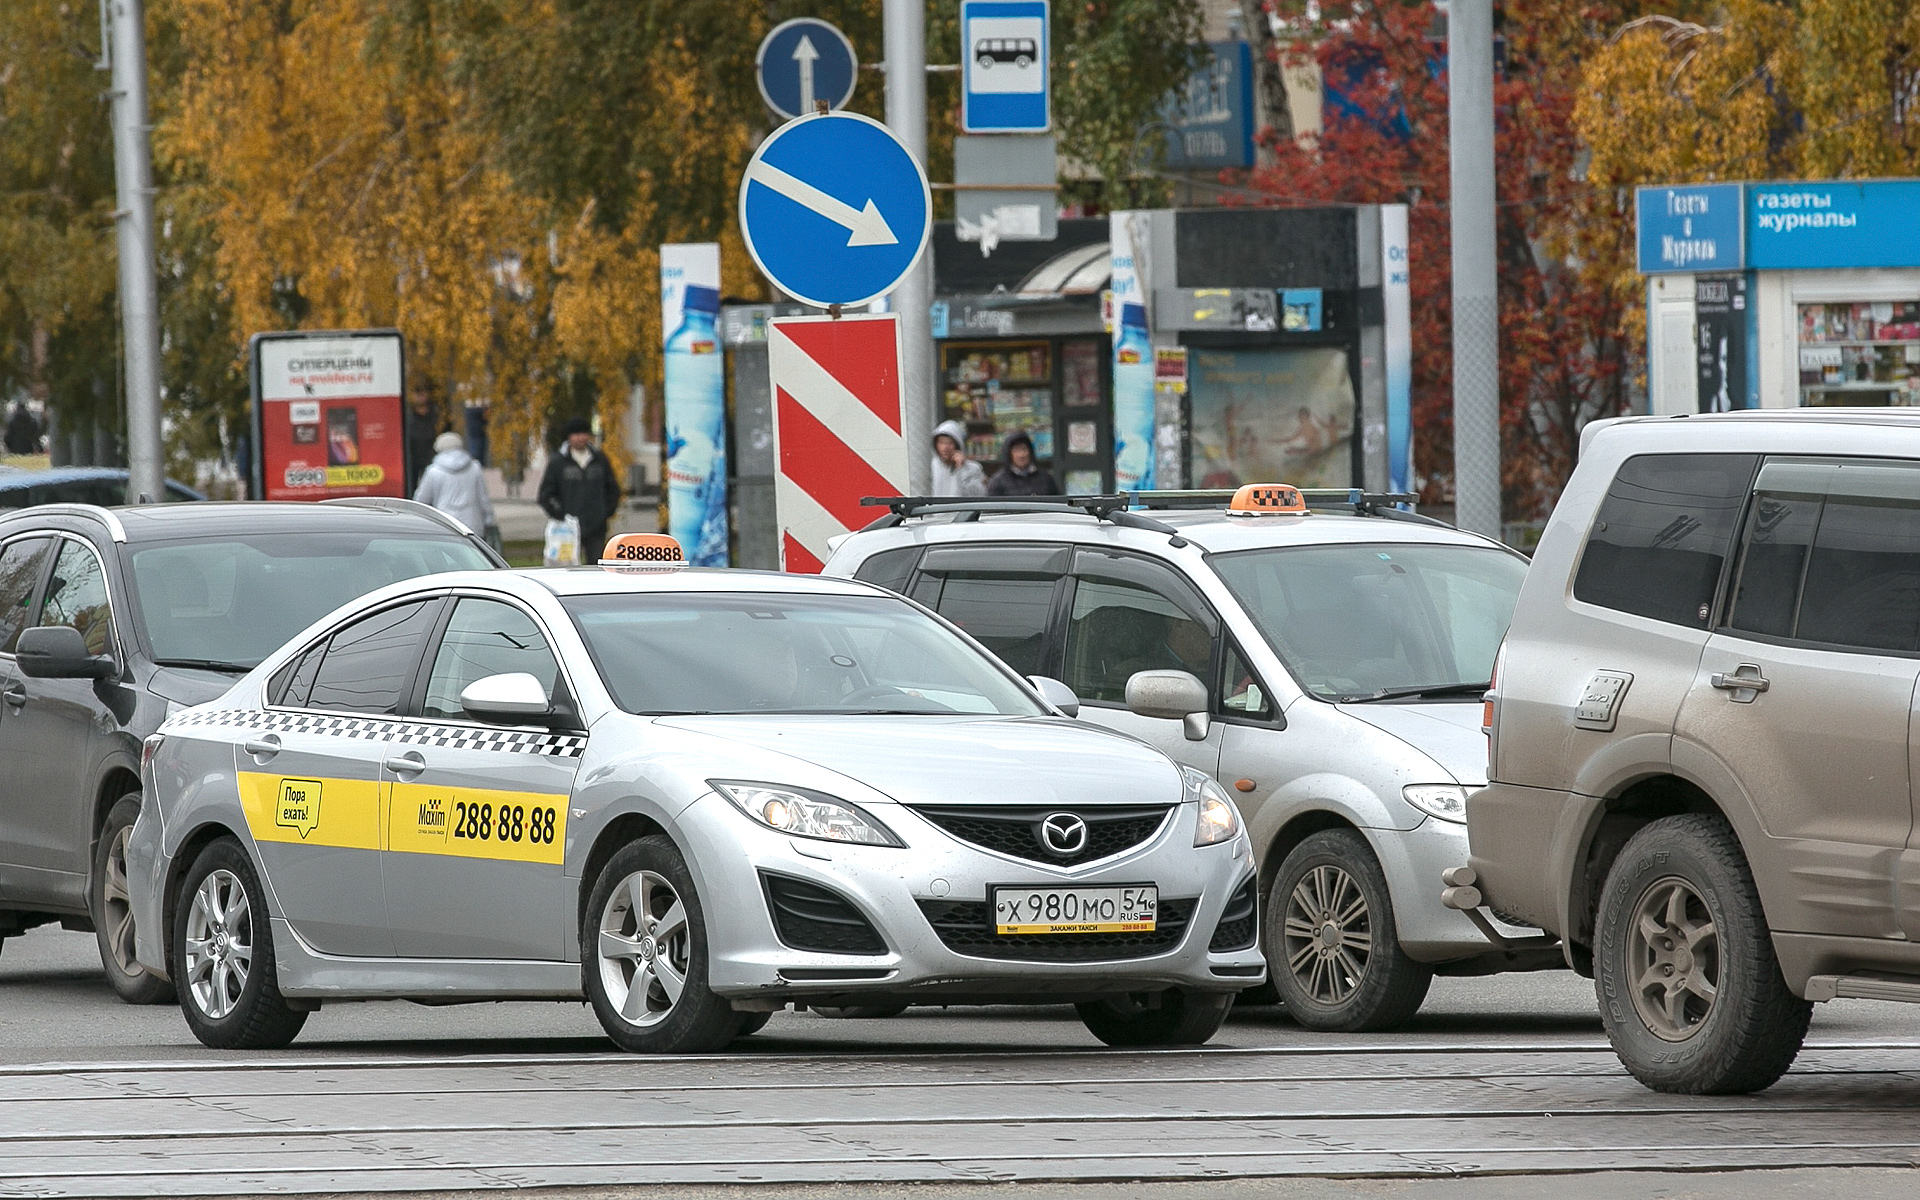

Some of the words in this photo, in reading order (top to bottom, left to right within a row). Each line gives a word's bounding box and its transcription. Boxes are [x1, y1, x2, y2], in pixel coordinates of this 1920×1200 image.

[1757, 193, 1832, 209] газеты
[1757, 212, 1857, 233] журналы
[287, 357, 373, 372] СУПЕРЦЕНЫ
[616, 544, 682, 561] 2888888
[284, 786, 306, 803] Пора
[282, 805, 309, 821] ехать!
[418, 804, 446, 826] Maxim
[1122, 889, 1149, 911] 54
[1120, 912, 1139, 921] RUS
